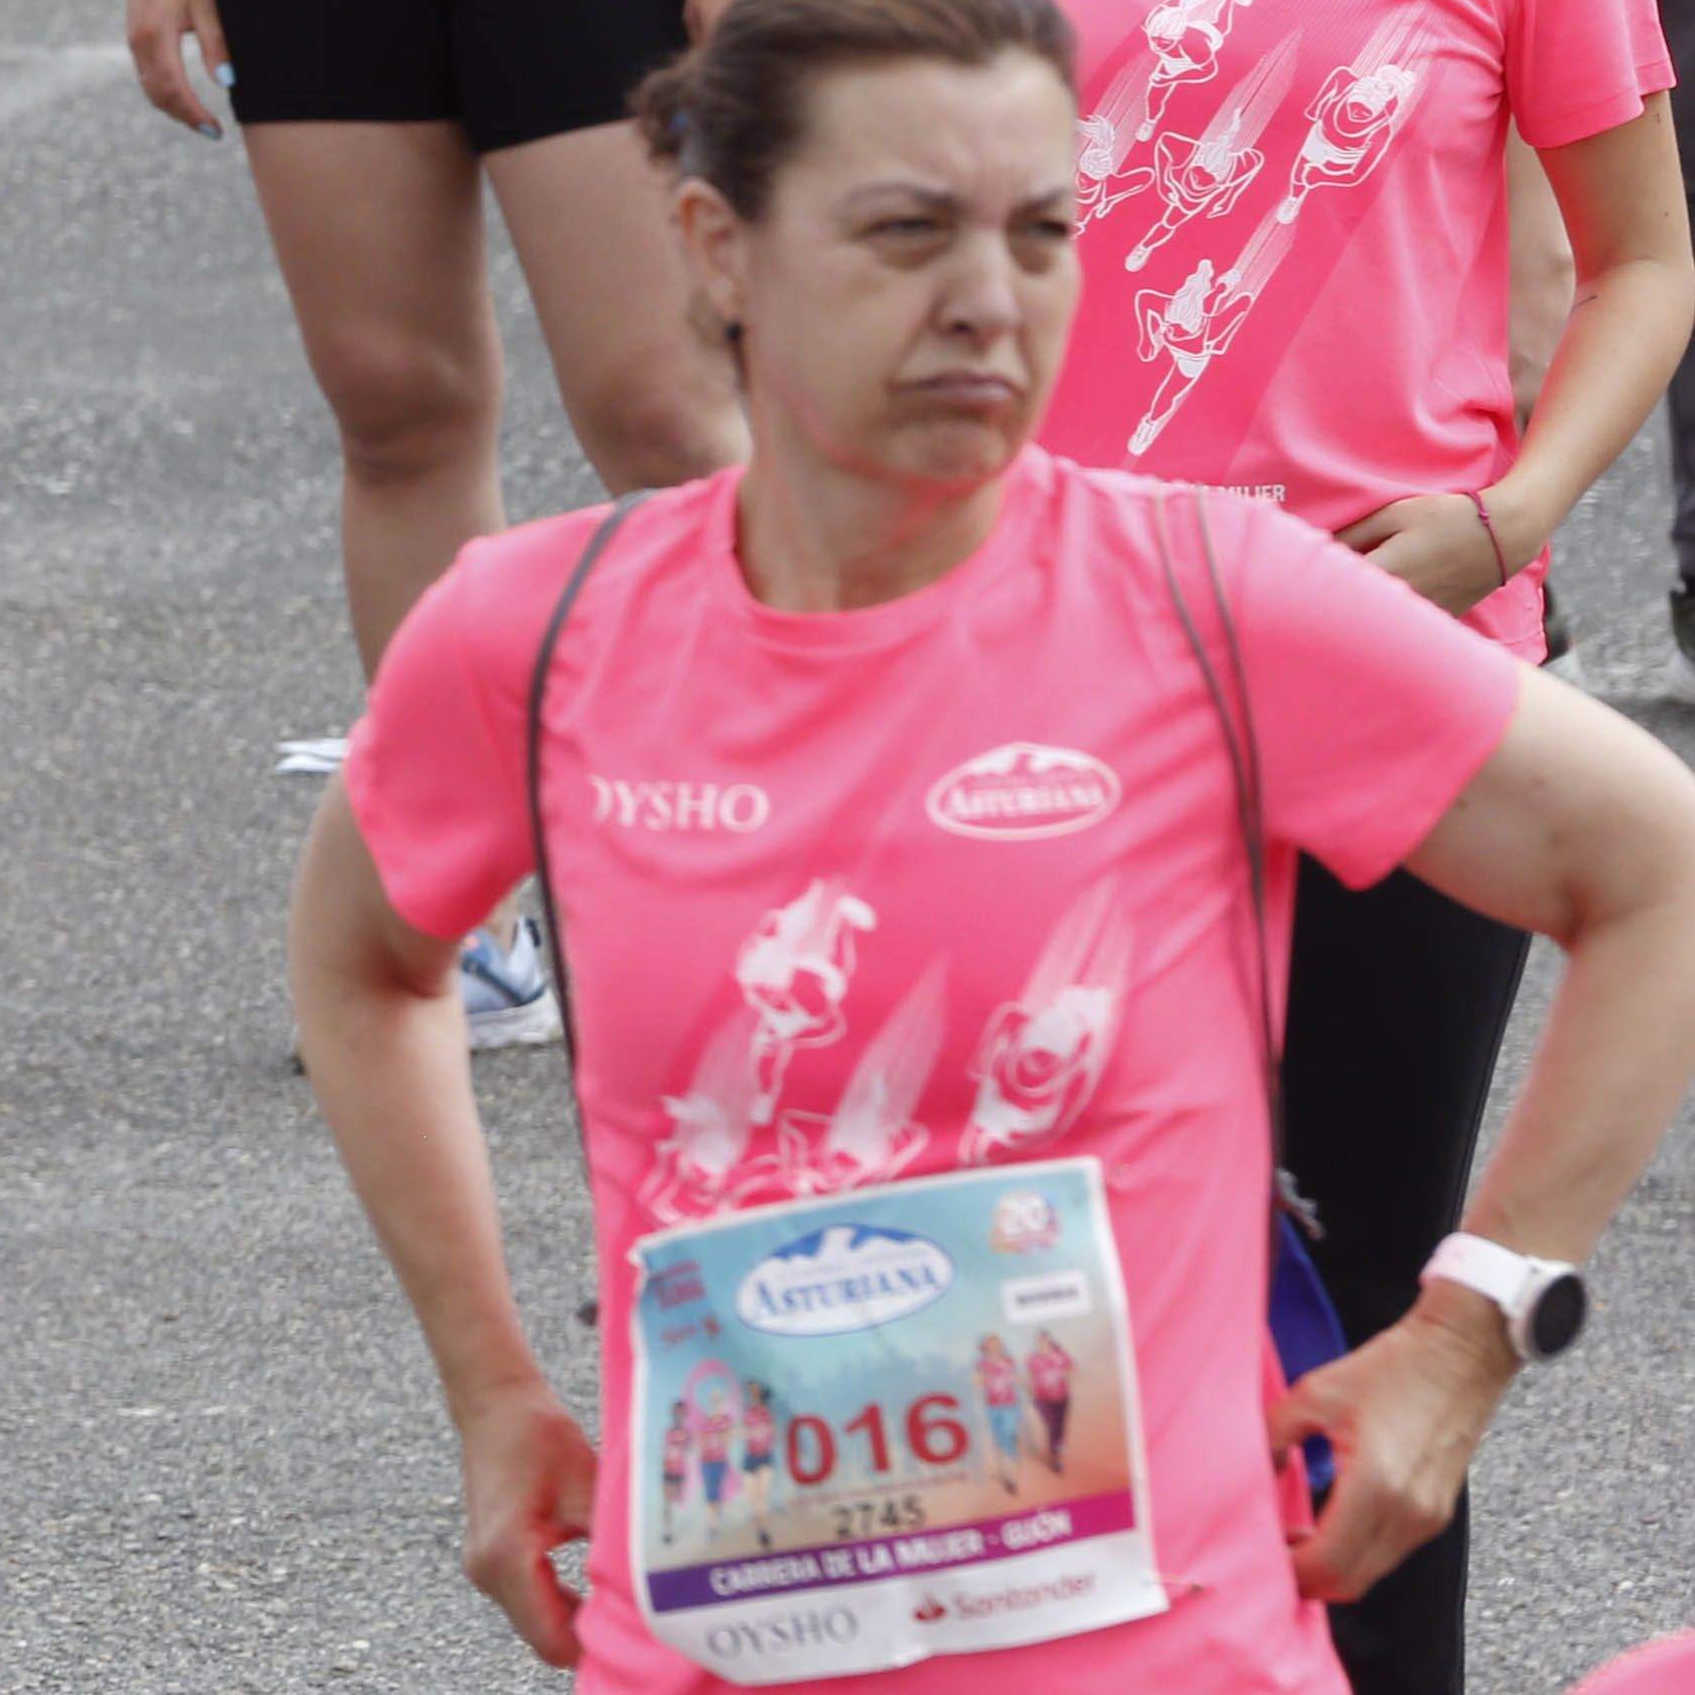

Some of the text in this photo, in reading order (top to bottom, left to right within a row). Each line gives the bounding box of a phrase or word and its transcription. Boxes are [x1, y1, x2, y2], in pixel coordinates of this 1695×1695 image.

[756, 1262, 943, 1321] ASTURIANA
[785, 1392, 970, 1486] 016
[833, 1493, 927, 1541] 2745
[709, 1552, 819, 1596] CARRERA
[821, 1546, 854, 1579] DE
[856, 1541, 890, 1574] LA
[893, 1530, 986, 1568] MUJER
[705, 1605, 860, 1661] OYSHO
